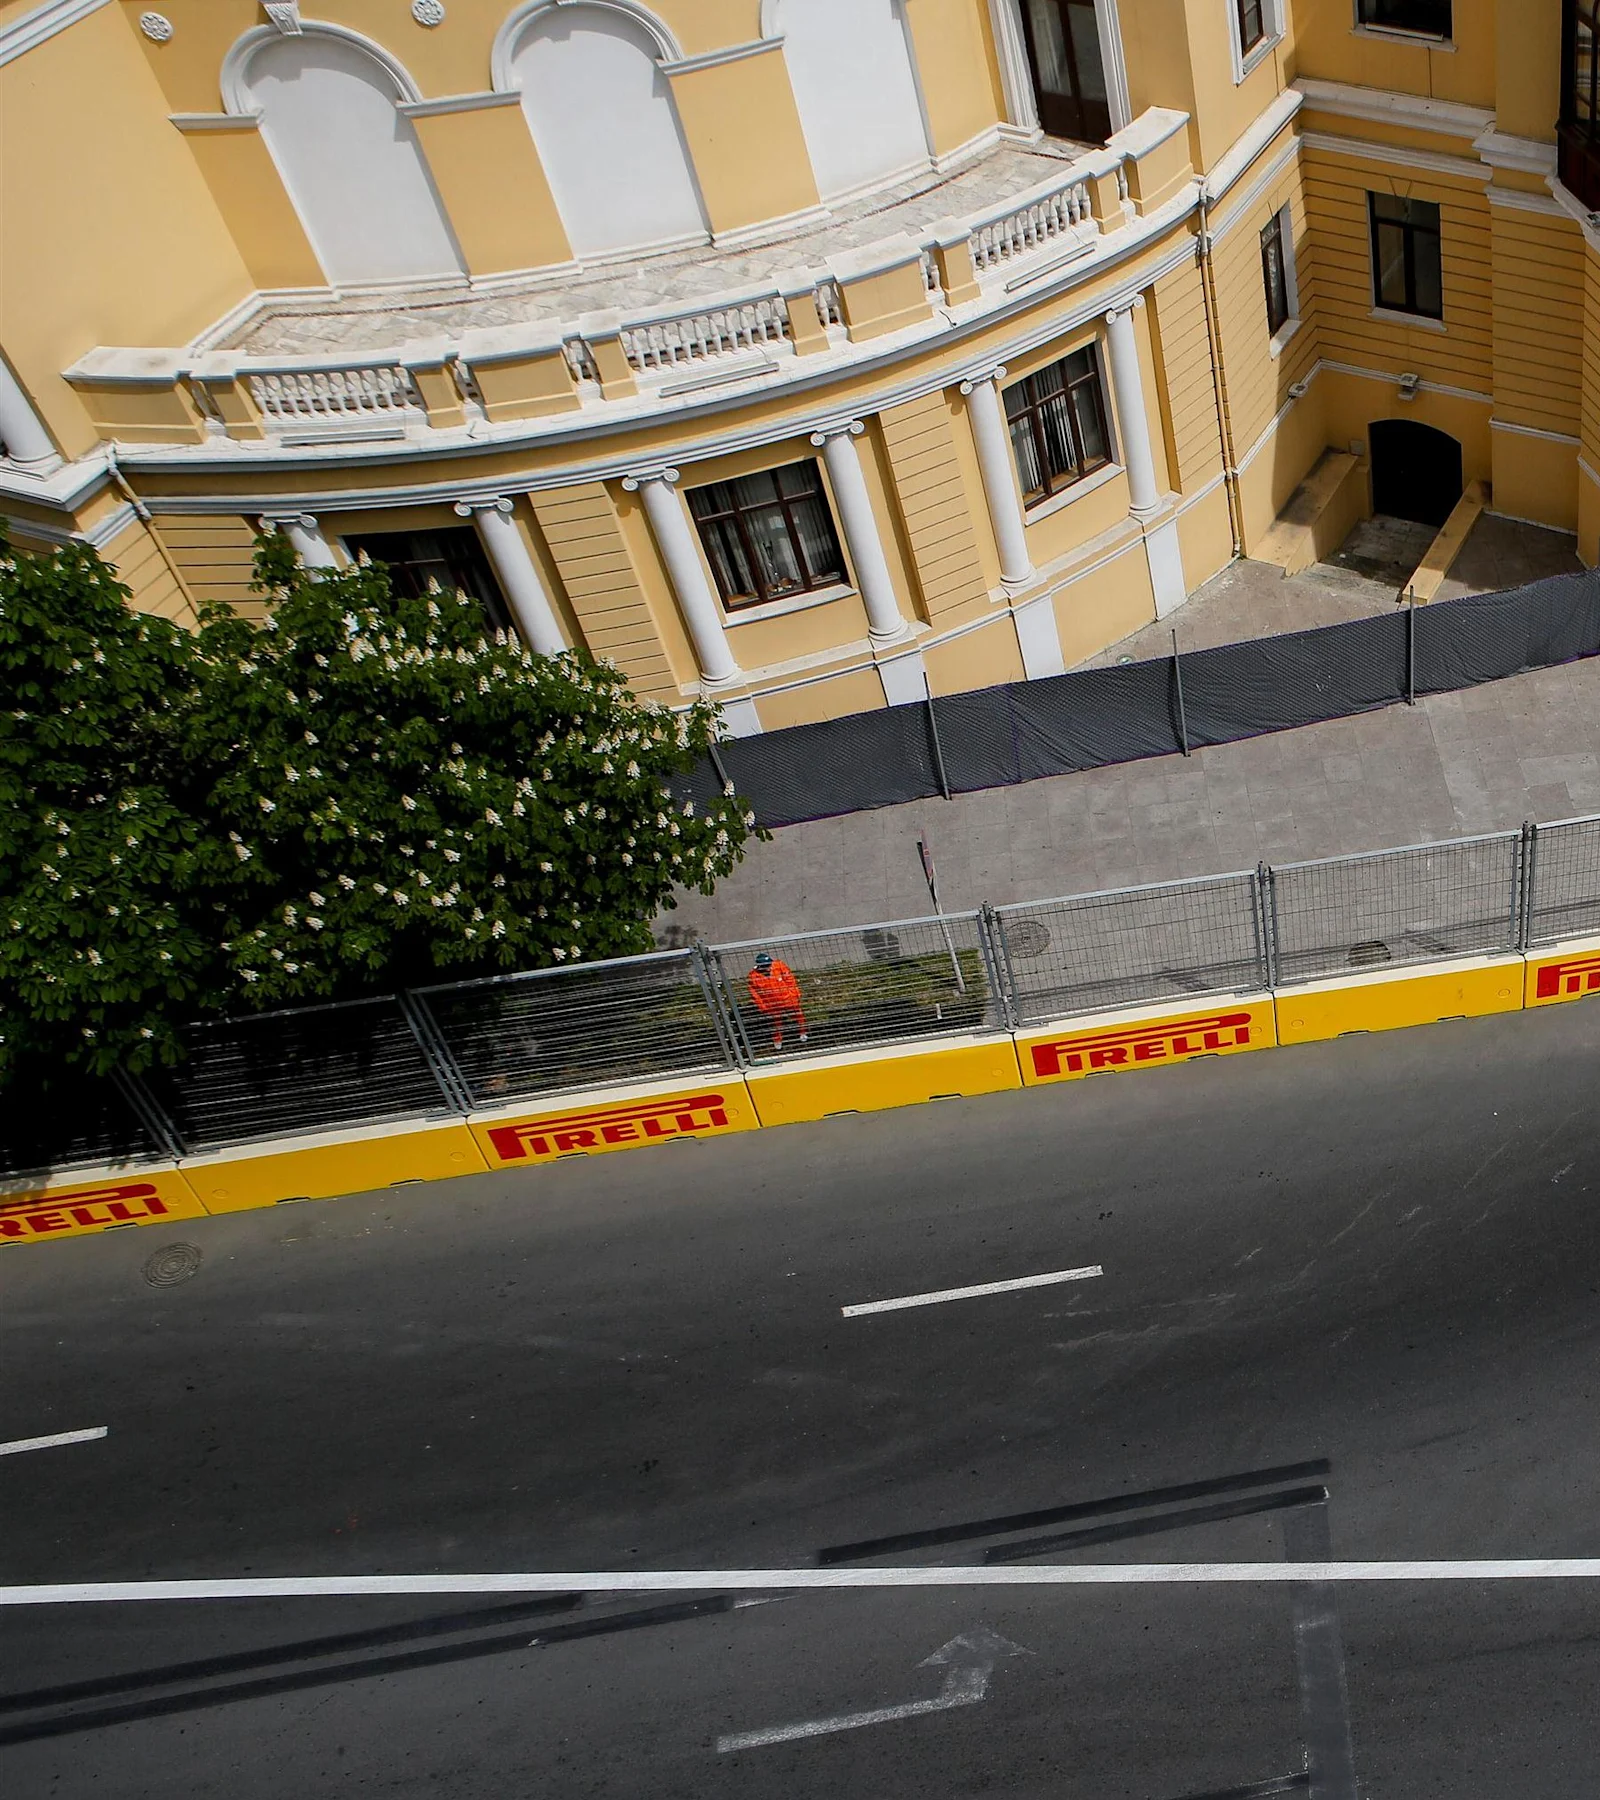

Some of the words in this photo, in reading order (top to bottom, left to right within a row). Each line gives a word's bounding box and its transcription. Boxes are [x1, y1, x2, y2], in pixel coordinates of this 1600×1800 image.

[1031, 1012, 1252, 1077] PIRELLI
[488, 1094, 729, 1161] PIRELLI
[0, 1183, 169, 1237] RELLI
